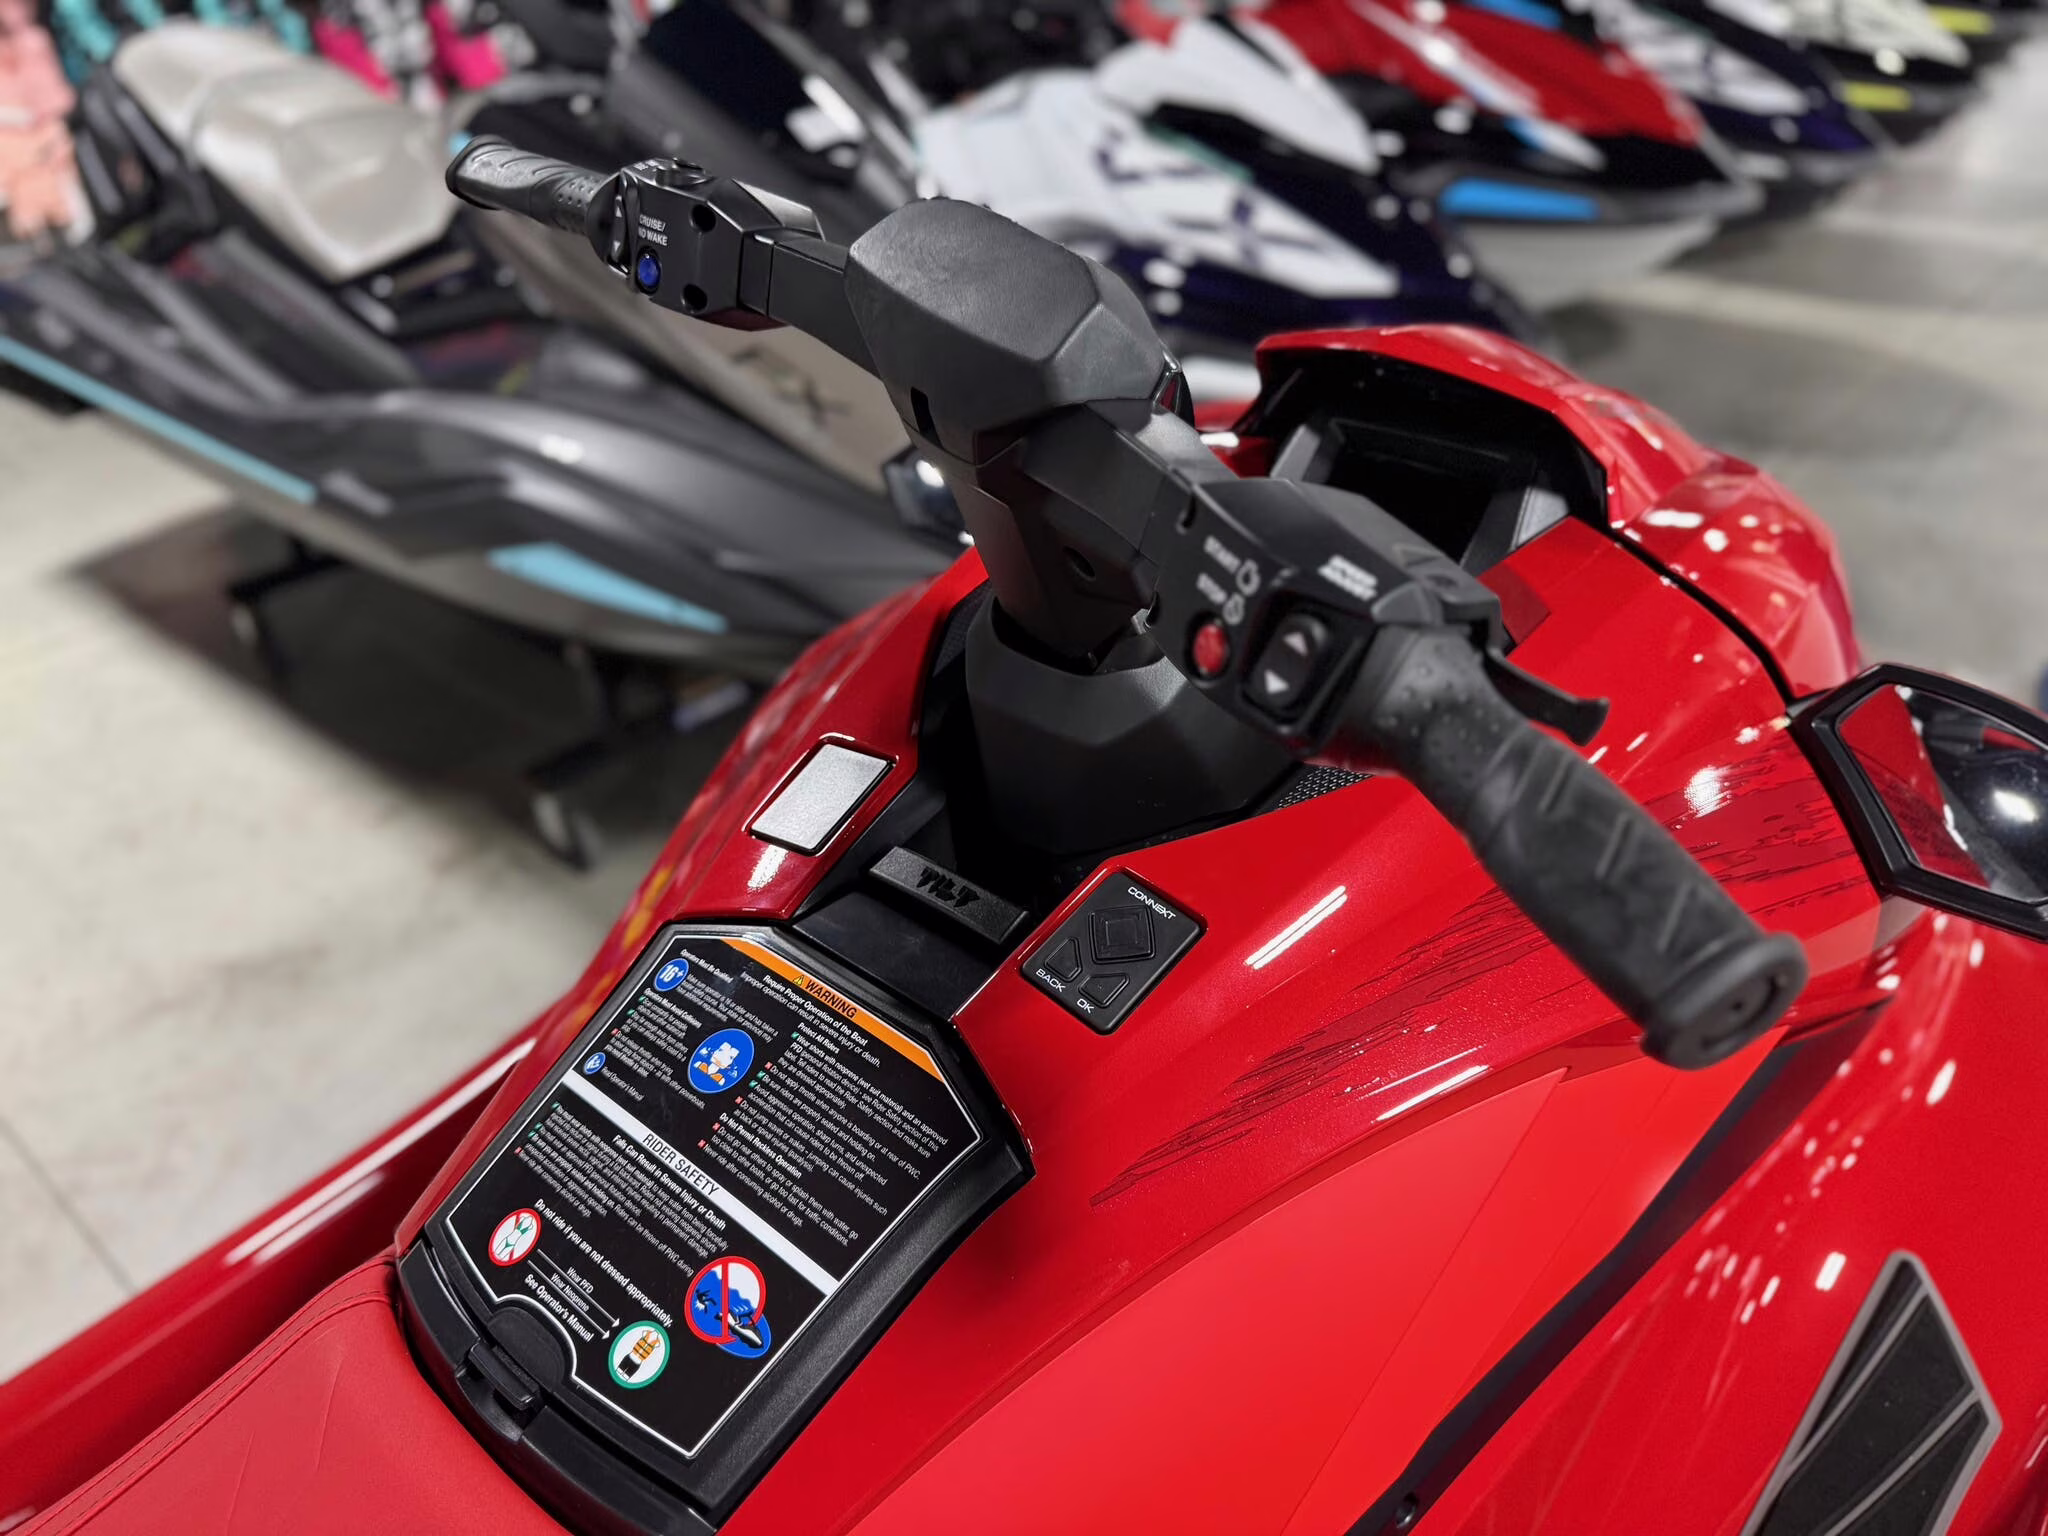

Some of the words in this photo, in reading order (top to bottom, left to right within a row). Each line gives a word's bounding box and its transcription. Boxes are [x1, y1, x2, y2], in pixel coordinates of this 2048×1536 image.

[640, 214, 666, 232] CRUISE/
[647, 230, 668, 246] WAKE
[917, 867, 980, 907] TILT
[1128, 887, 1176, 920] CONNEXT
[659, 965, 685, 983] 16+
[1036, 968, 1066, 993] BACK
[762, 973, 786, 992] Require
[783, 987, 805, 1005] Proper
[802, 999, 834, 1024] Operation
[831, 1019, 843, 1028] of
[838, 1023, 853, 1036] the
[849, 1030, 869, 1046] Boat
[803, 978, 859, 1019] WARNING
[1076, 998, 1095, 1014] OK
[740, 969, 764, 989] Improper
[761, 985, 789, 1005] operation
[785, 1001, 799, 1012] can
[796, 1007, 816, 1022] result
[811, 1016, 821, 1026] in
[817, 1021, 840, 1038] severe
[836, 1033, 856, 1050] injury
[853, 1045, 863, 1054] or
[860, 1048, 882, 1067] death.
[796, 1021, 818, 1038] Protect
[814, 1032, 826, 1043] All
[821, 1037, 841, 1053] Riders
[790, 1040, 804, 1053] PFD
[860, 1092, 873, 1103] see
[870, 1098, 887, 1113] Rider
[883, 1108, 904, 1126] Safety
[900, 1121, 923, 1139] section
[920, 1135, 931, 1144] of
[926, 1138, 940, 1151] this
[795, 1033, 811, 1047] Wear
[808, 1043, 826, 1058] shorts
[823, 1054, 837, 1065] with
[833, 1061, 859, 1081] neoprene
[867, 1085, 882, 1097] suit
[900, 1109, 916, 1121] and
[911, 1116, 922, 1126] an
[919, 1122, 950, 1145] approved
[761, 1073, 771, 1083] Be
[768, 1079, 782, 1091] sure
[778, 1086, 795, 1101] riders
[791, 1096, 803, 1107] are
[798, 1102, 823, 1122] properly
[819, 1117, 841, 1133] seated
[836, 1129, 851, 1141] and
[846, 1135, 869, 1156] holding
[769, 1064, 780, 1074] Do
[776, 1070, 789, 1080] not
[784, 1076, 800, 1091] apply
[797, 1084, 817, 1102] throttle
[813, 1097, 830, 1112] when
[827, 1107, 848, 1125] anyone
[850, 1123, 876, 1146] boarding
[885, 1150, 900, 1163] rear
[711, 1132, 722, 1144] too
[719, 1111, 729, 1122] Do
[726, 1116, 740, 1129] Not
[735, 1123, 756, 1141] Permit
[751, 1136, 777, 1159] Reckless
[774, 1153, 803, 1179] Operation
[747, 1091, 777, 1115] acceleration
[774, 1109, 788, 1122] that
[783, 1118, 796, 1129] can
[792, 1125, 811, 1140] cause
[807, 1136, 825, 1151] riders
[822, 1145, 831, 1155] to
[835, 1155, 857, 1174] thrown
[753, 1082, 771, 1097] Avoid
[766, 1093, 794, 1115] aggressive
[814, 1128, 832, 1145] sharp
[843, 1150, 858, 1162] and
[854, 1158, 889, 1185] unexpected
[718, 1140, 734, 1154] close
[731, 1148, 740, 1158] to
[739, 1098, 750, 1109] Do
[746, 1105, 759, 1115] not
[753, 1110, 770, 1126] jump
[766, 1120, 784, 1136] waves
[781, 1132, 790, 1140] or
[787, 1136, 806, 1152] wakes
[805, 1150, 830, 1172] jumping
[826, 1166, 840, 1178] can
[837, 1174, 856, 1191] cause
[852, 1185, 875, 1205] injuries
[872, 1201, 890, 1216] such
[641, 1132, 679, 1165] RIDER
[673, 1157, 720, 1197] SAFETY
[736, 1154, 752, 1168] other
[612, 1133, 628, 1149] Falls
[624, 1143, 639, 1158] Can
[635, 1152, 658, 1173] Result
[653, 1167, 663, 1178] in
[659, 1172, 683, 1194] Severe
[679, 1188, 700, 1209] Injury
[696, 1203, 708, 1214] or
[704, 1208, 728, 1230] Death
[717, 1124, 728, 1135] Do
[724, 1131, 737, 1142] not
[731, 1137, 742, 1147] go
[739, 1143, 753, 1155] near
[749, 1151, 768, 1167] others
[764, 1162, 774, 1172] to
[770, 1168, 787, 1184] spray
[784, 1178, 793, 1187] or
[790, 1183, 811, 1201] splash
[807, 1195, 824, 1211] them
[820, 1207, 836, 1220] with
[847, 1229, 860, 1240] go
[764, 1176, 773, 1185] or
[768, 1180, 780, 1190] go
[777, 1185, 789, 1197] too
[534, 1197, 546, 1211] Do
[542, 1206, 557, 1219] not
[785, 1192, 800, 1206] fast
[796, 1200, 807, 1212] for
[552, 1214, 567, 1229] ride
[563, 1223, 573, 1234] if
[803, 1206, 822, 1224] traffic
[566, 1229, 582, 1244] you
[579, 1239, 593, 1253] are
[589, 1249, 605, 1263] not
[565, 1265, 582, 1283] Wear
[578, 1277, 595, 1294] PFD
[600, 1257, 631, 1286] dressed
[550, 1271, 566, 1289] Wear
[562, 1283, 590, 1312] Neoprene
[625, 1282, 673, 1328] appropriately.
[524, 1272, 539, 1290] See
[535, 1283, 570, 1319] Operator's
[566, 1312, 595, 1342] Manual
